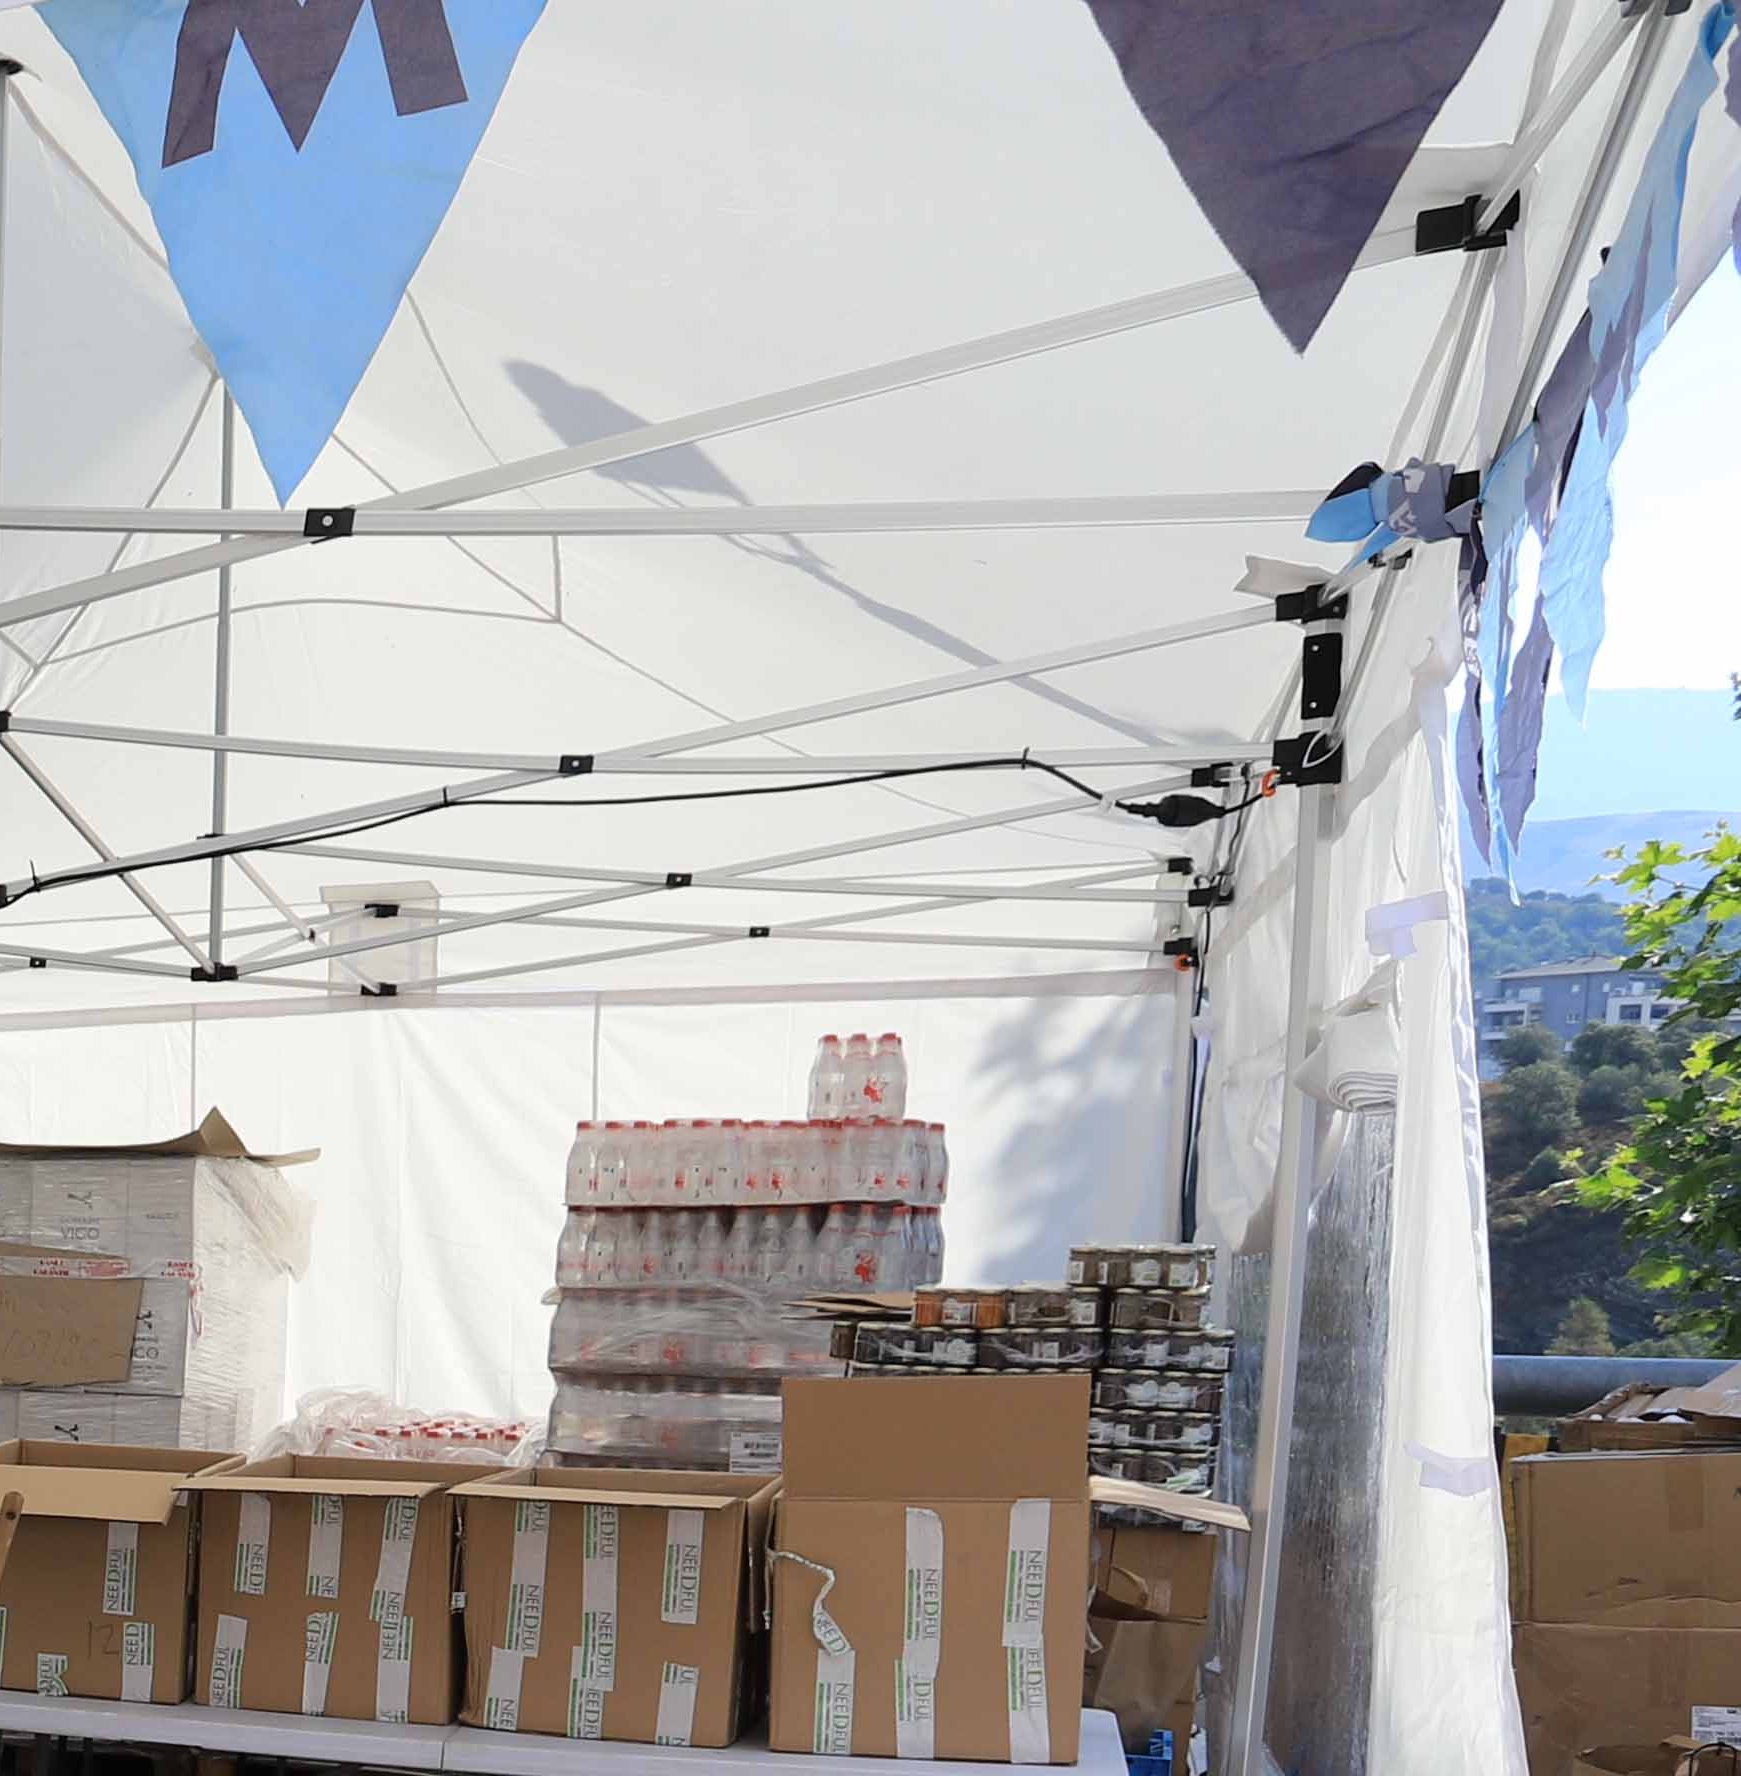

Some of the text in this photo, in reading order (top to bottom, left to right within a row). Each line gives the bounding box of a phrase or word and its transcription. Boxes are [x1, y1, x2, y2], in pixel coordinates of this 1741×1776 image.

[61, 1227, 100, 1240] VICO
[600, 1505, 617, 1560] EEDFUL
[107, 1549, 122, 1612] NEEDFUL
[678, 1544, 699, 1614] NEEDFUL
[924, 1568, 940, 1640] NEEDFUL
[1024, 1550, 1045, 1623] NEEDFUL
[125, 1624, 140, 1666] NEED
[522, 1584, 541, 1653] NEEDFUL
[597, 1611, 615, 1680] NEEDFUL
[833, 1682, 850, 1753] NEEDFUL
